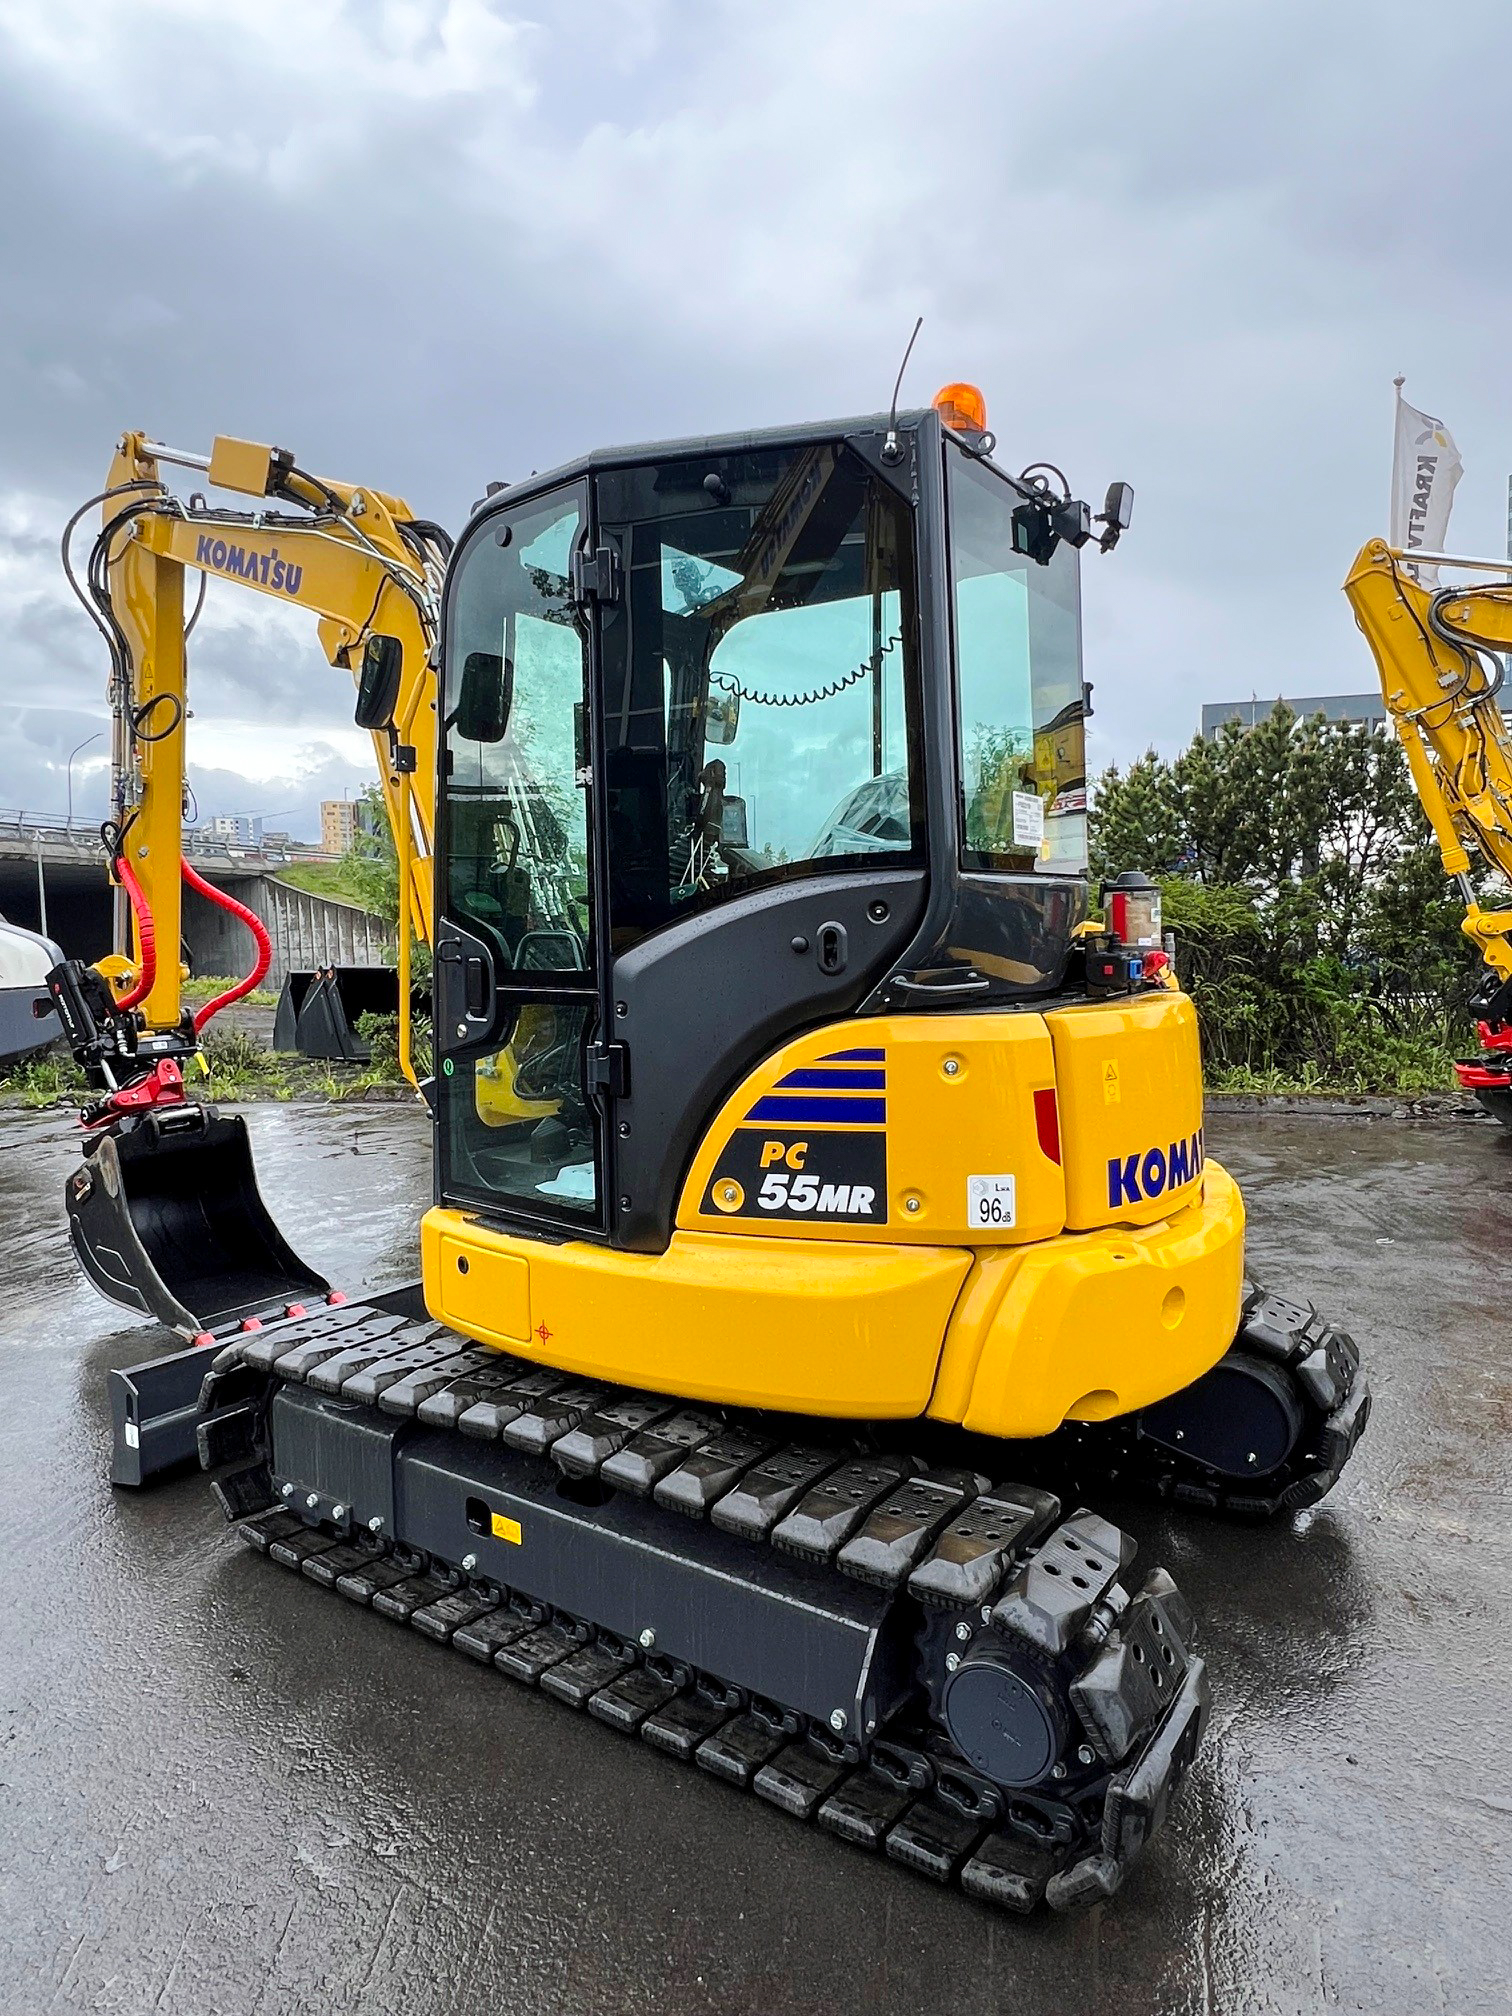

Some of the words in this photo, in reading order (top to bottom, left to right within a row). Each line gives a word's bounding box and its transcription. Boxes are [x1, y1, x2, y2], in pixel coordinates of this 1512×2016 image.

[196, 533, 303, 595] KOMATSU
[759, 1141, 808, 1170] PC
[1107, 1128, 1203, 1208] KOMA
[757, 1173, 876, 1214] 55MR
[979, 1197, 1002, 1223] 96
